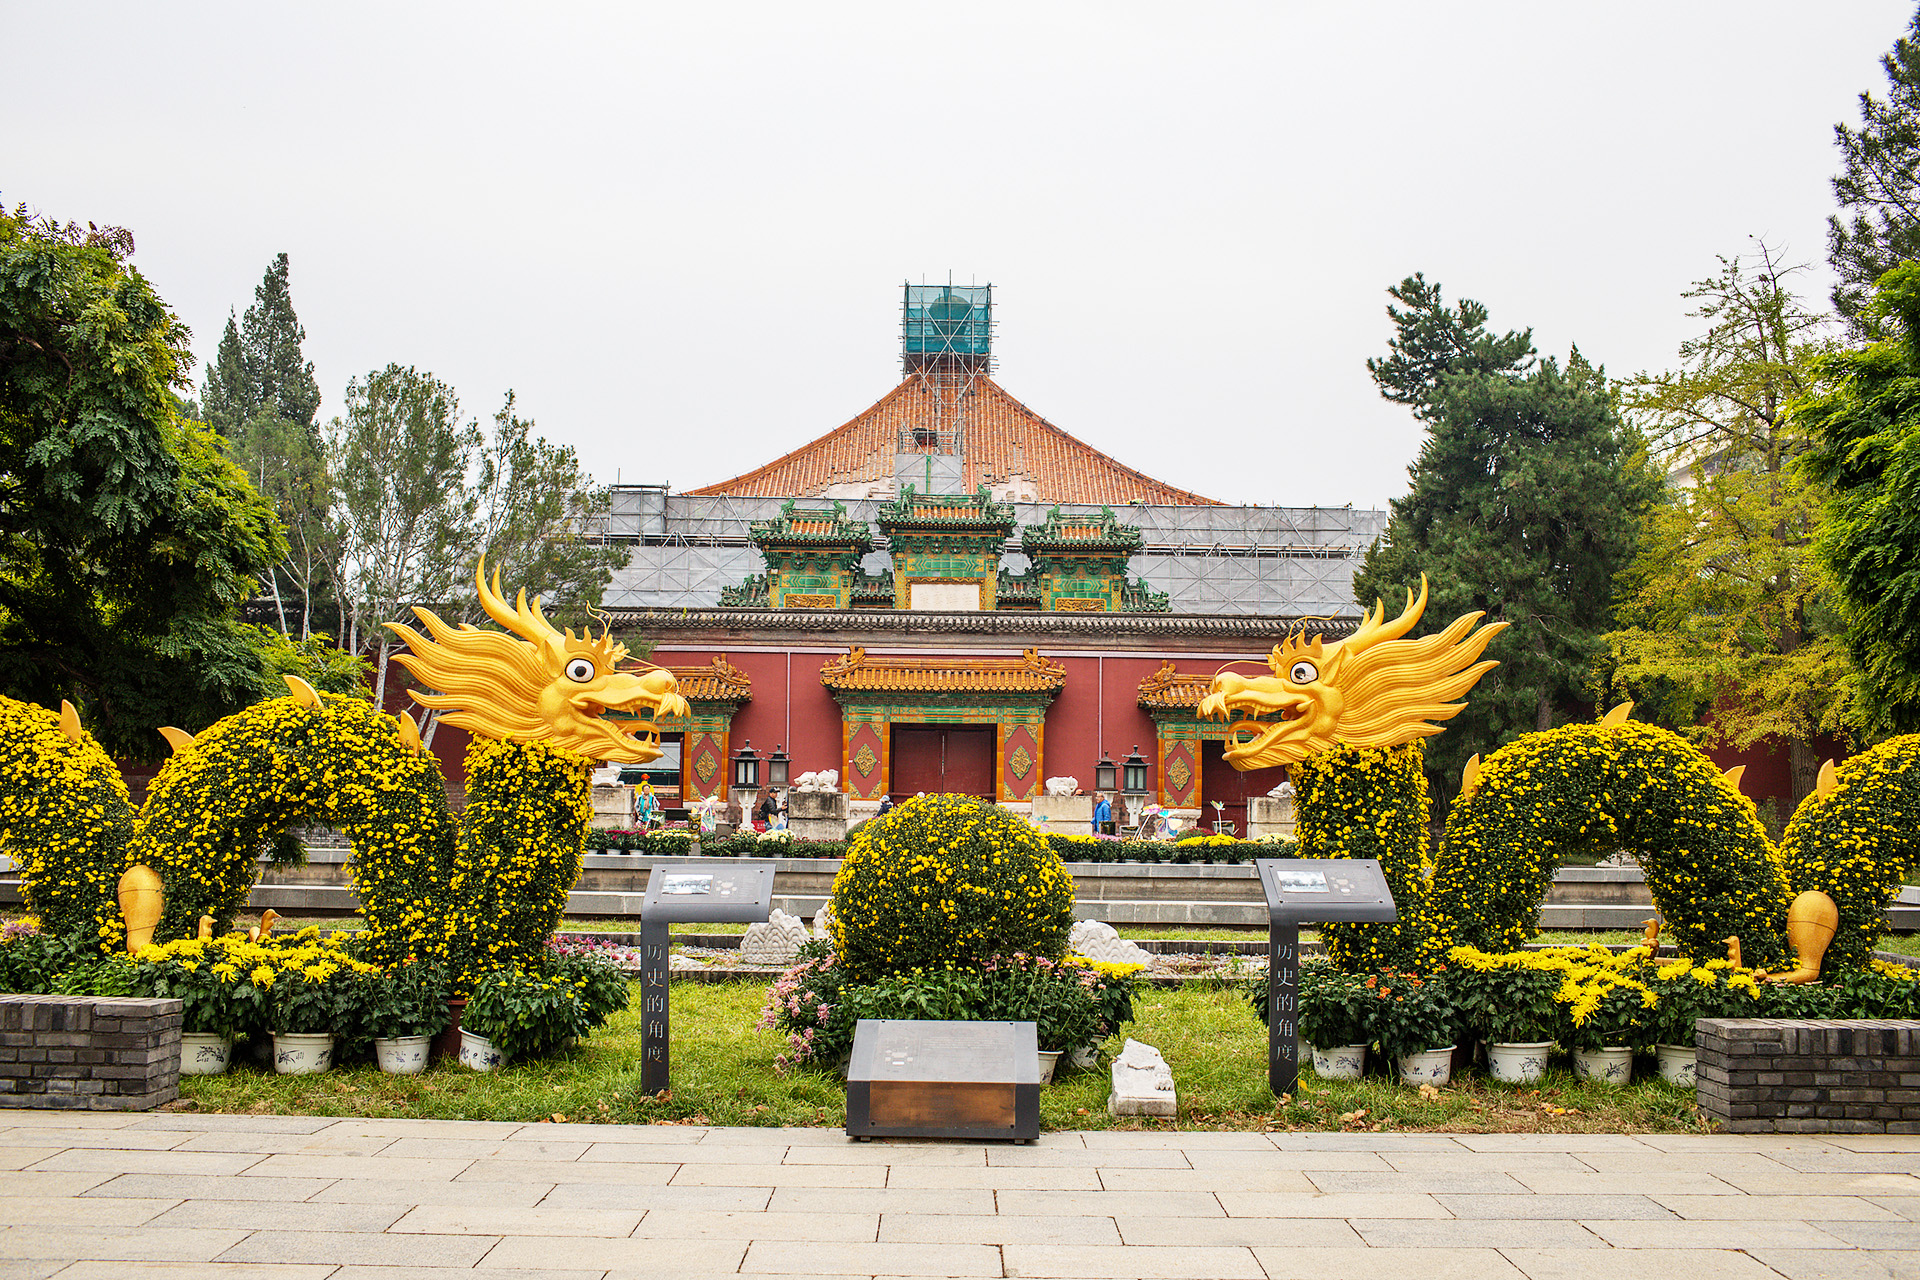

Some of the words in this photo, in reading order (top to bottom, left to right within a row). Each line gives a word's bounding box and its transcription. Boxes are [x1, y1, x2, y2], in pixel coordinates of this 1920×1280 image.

[646, 943, 664, 1064] 历史的角度
[1276, 943, 1294, 1061] 历史的角度
